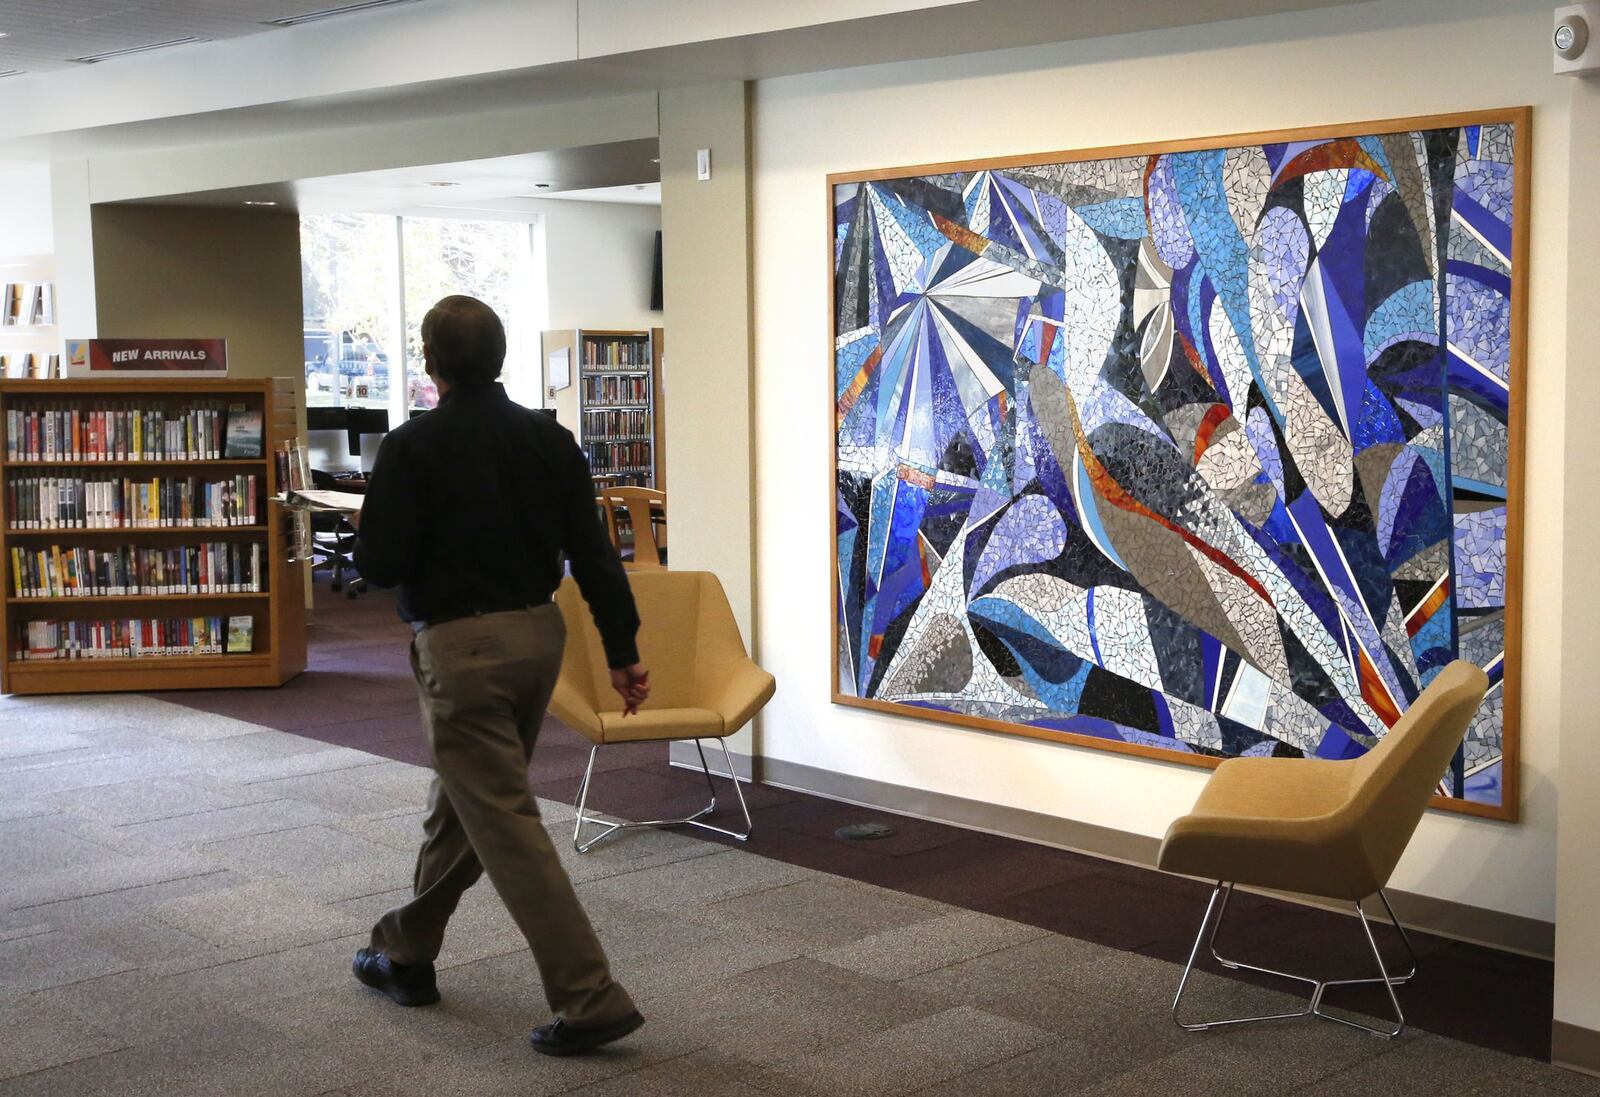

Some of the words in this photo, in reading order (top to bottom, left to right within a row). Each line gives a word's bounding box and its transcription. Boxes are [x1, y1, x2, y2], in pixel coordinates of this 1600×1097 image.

[112, 349, 139, 363] NEW
[143, 350, 206, 360] ARRIVALS
[357, 387, 367, 396] 10
[411, 389, 416, 398] 7
